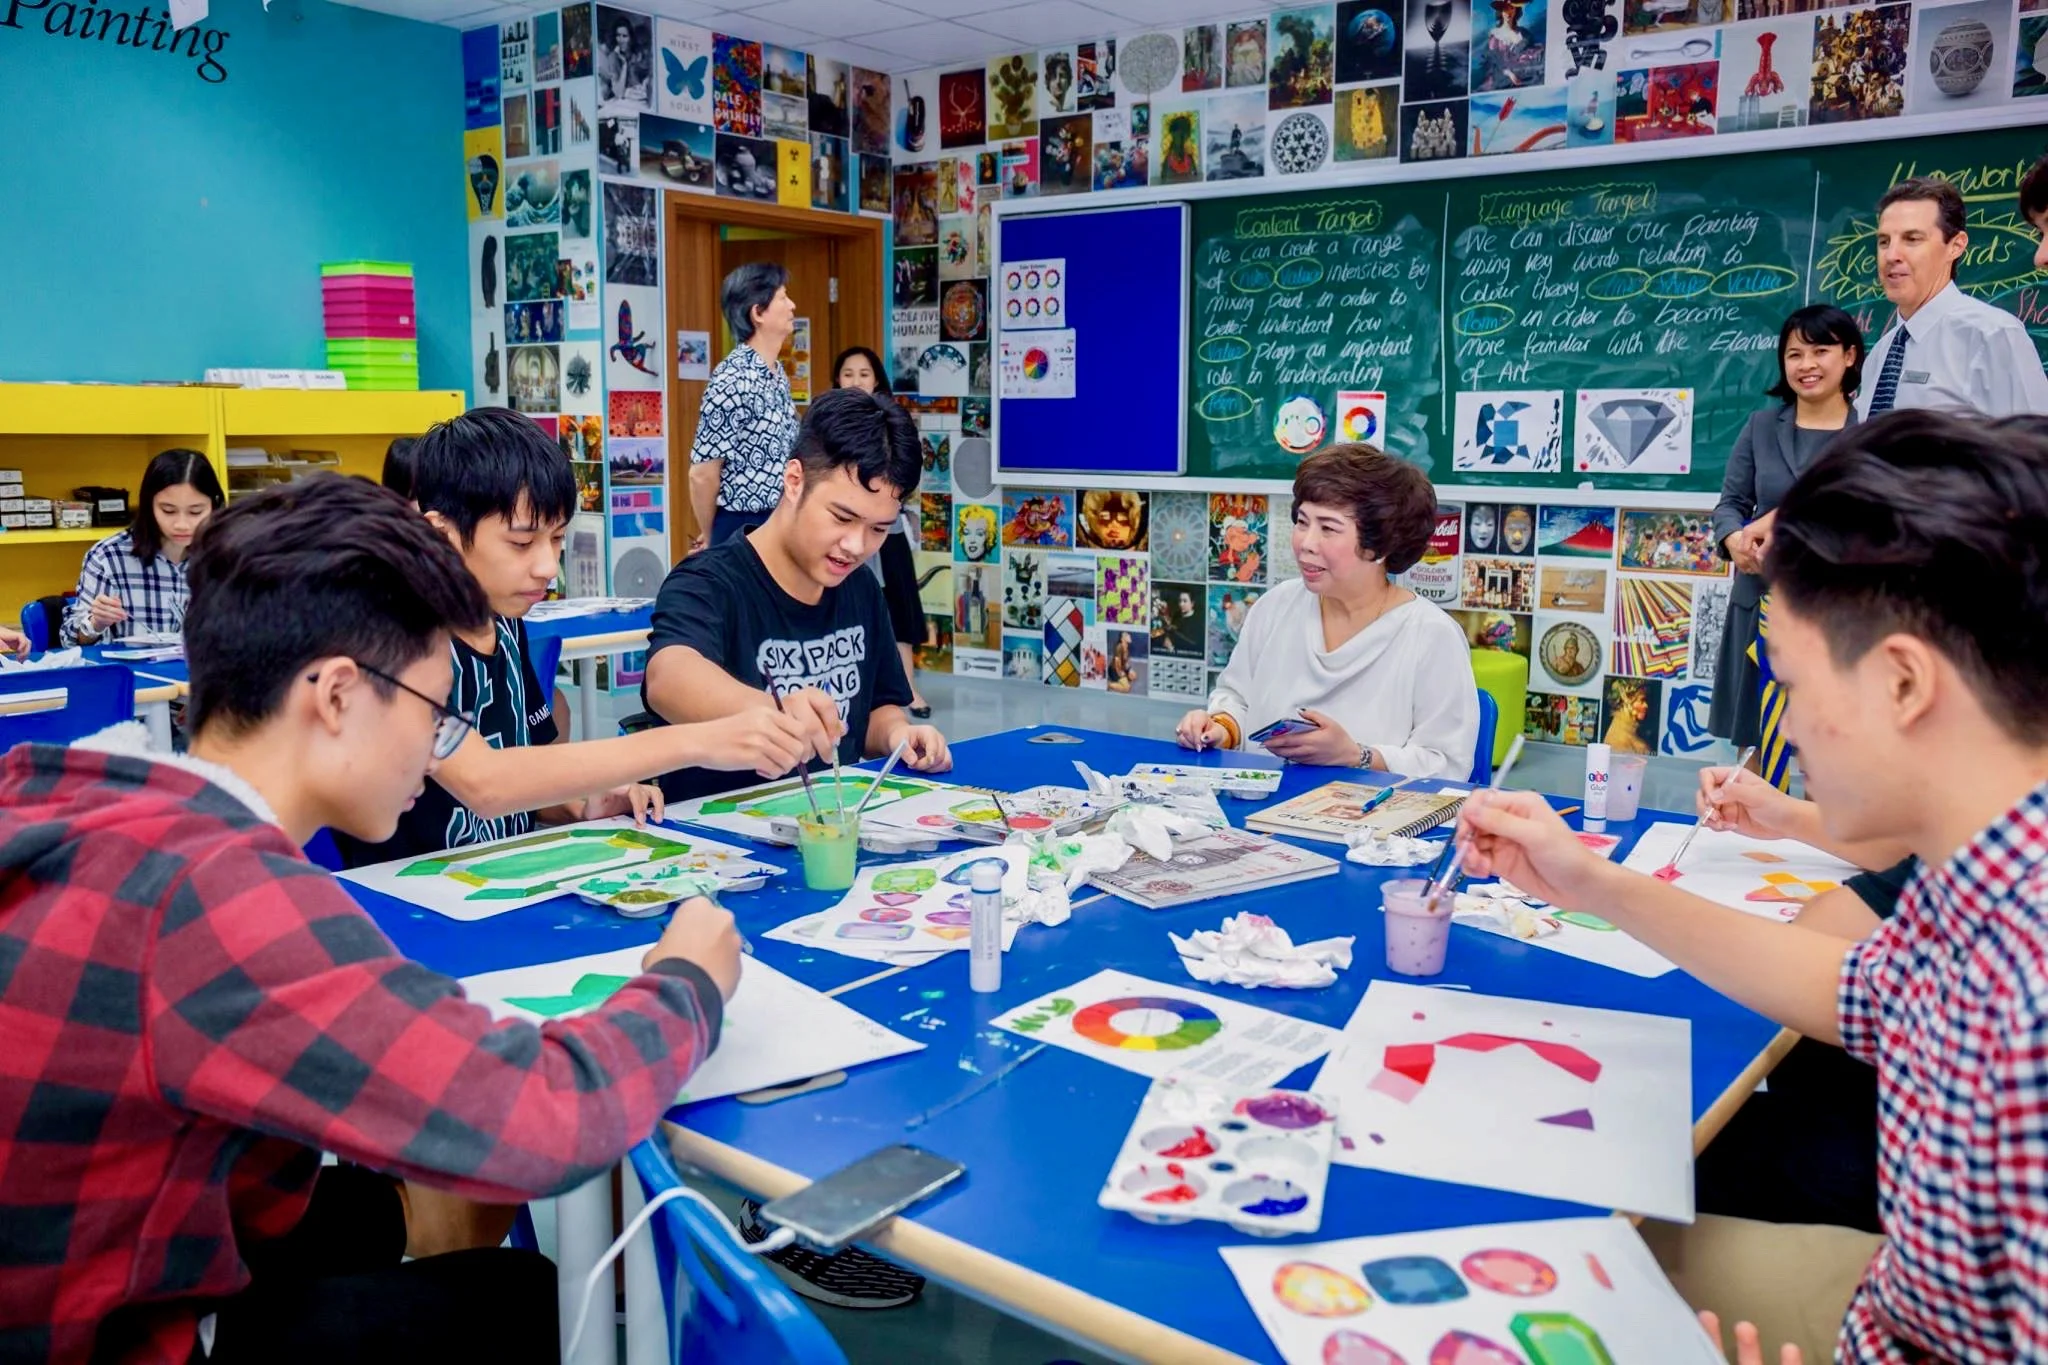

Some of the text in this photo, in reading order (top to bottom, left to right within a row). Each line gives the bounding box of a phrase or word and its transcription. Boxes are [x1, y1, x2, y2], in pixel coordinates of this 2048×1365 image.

[714, 91, 742, 105] DALE
[1241, 207, 1376, 236] Content Target
[1485, 195, 1574, 231] Language
[1465, 229, 1498, 254] We
[1558, 221, 1615, 247] discuss
[1207, 247, 1231, 265] We
[1460, 249, 1511, 280] using
[1637, 240, 1706, 270] relating
[1722, 244, 1743, 265] to
[1207, 268, 1225, 294] of
[1407, 256, 1431, 290] by
[1205, 295, 1254, 322] mixing
[1340, 287, 1380, 307] order
[1388, 287, 1407, 306] to
[1460, 279, 1521, 303] Colour
[1205, 310, 1382, 338] better understand how
[1520, 309, 1544, 327] in
[1552, 306, 1603, 328] order
[1613, 303, 1636, 327] to
[1654, 300, 1742, 326] become
[1459, 338, 1505, 358] more
[1655, 328, 1691, 355] the
[1708, 330, 1780, 352] Elemen
[1206, 366, 1237, 386] role
[1276, 363, 1384, 393] understanding
[1461, 359, 1533, 392] of Art
[1410, 573, 1453, 582] MUSHROOM
[1414, 587, 1446, 598] SOUP
[764, 633, 863, 670] SIX PACK
[528, 704, 551, 726] GAME
[1278, 813, 1313, 822] PAD
[1267, 851, 1302, 863] PAD
